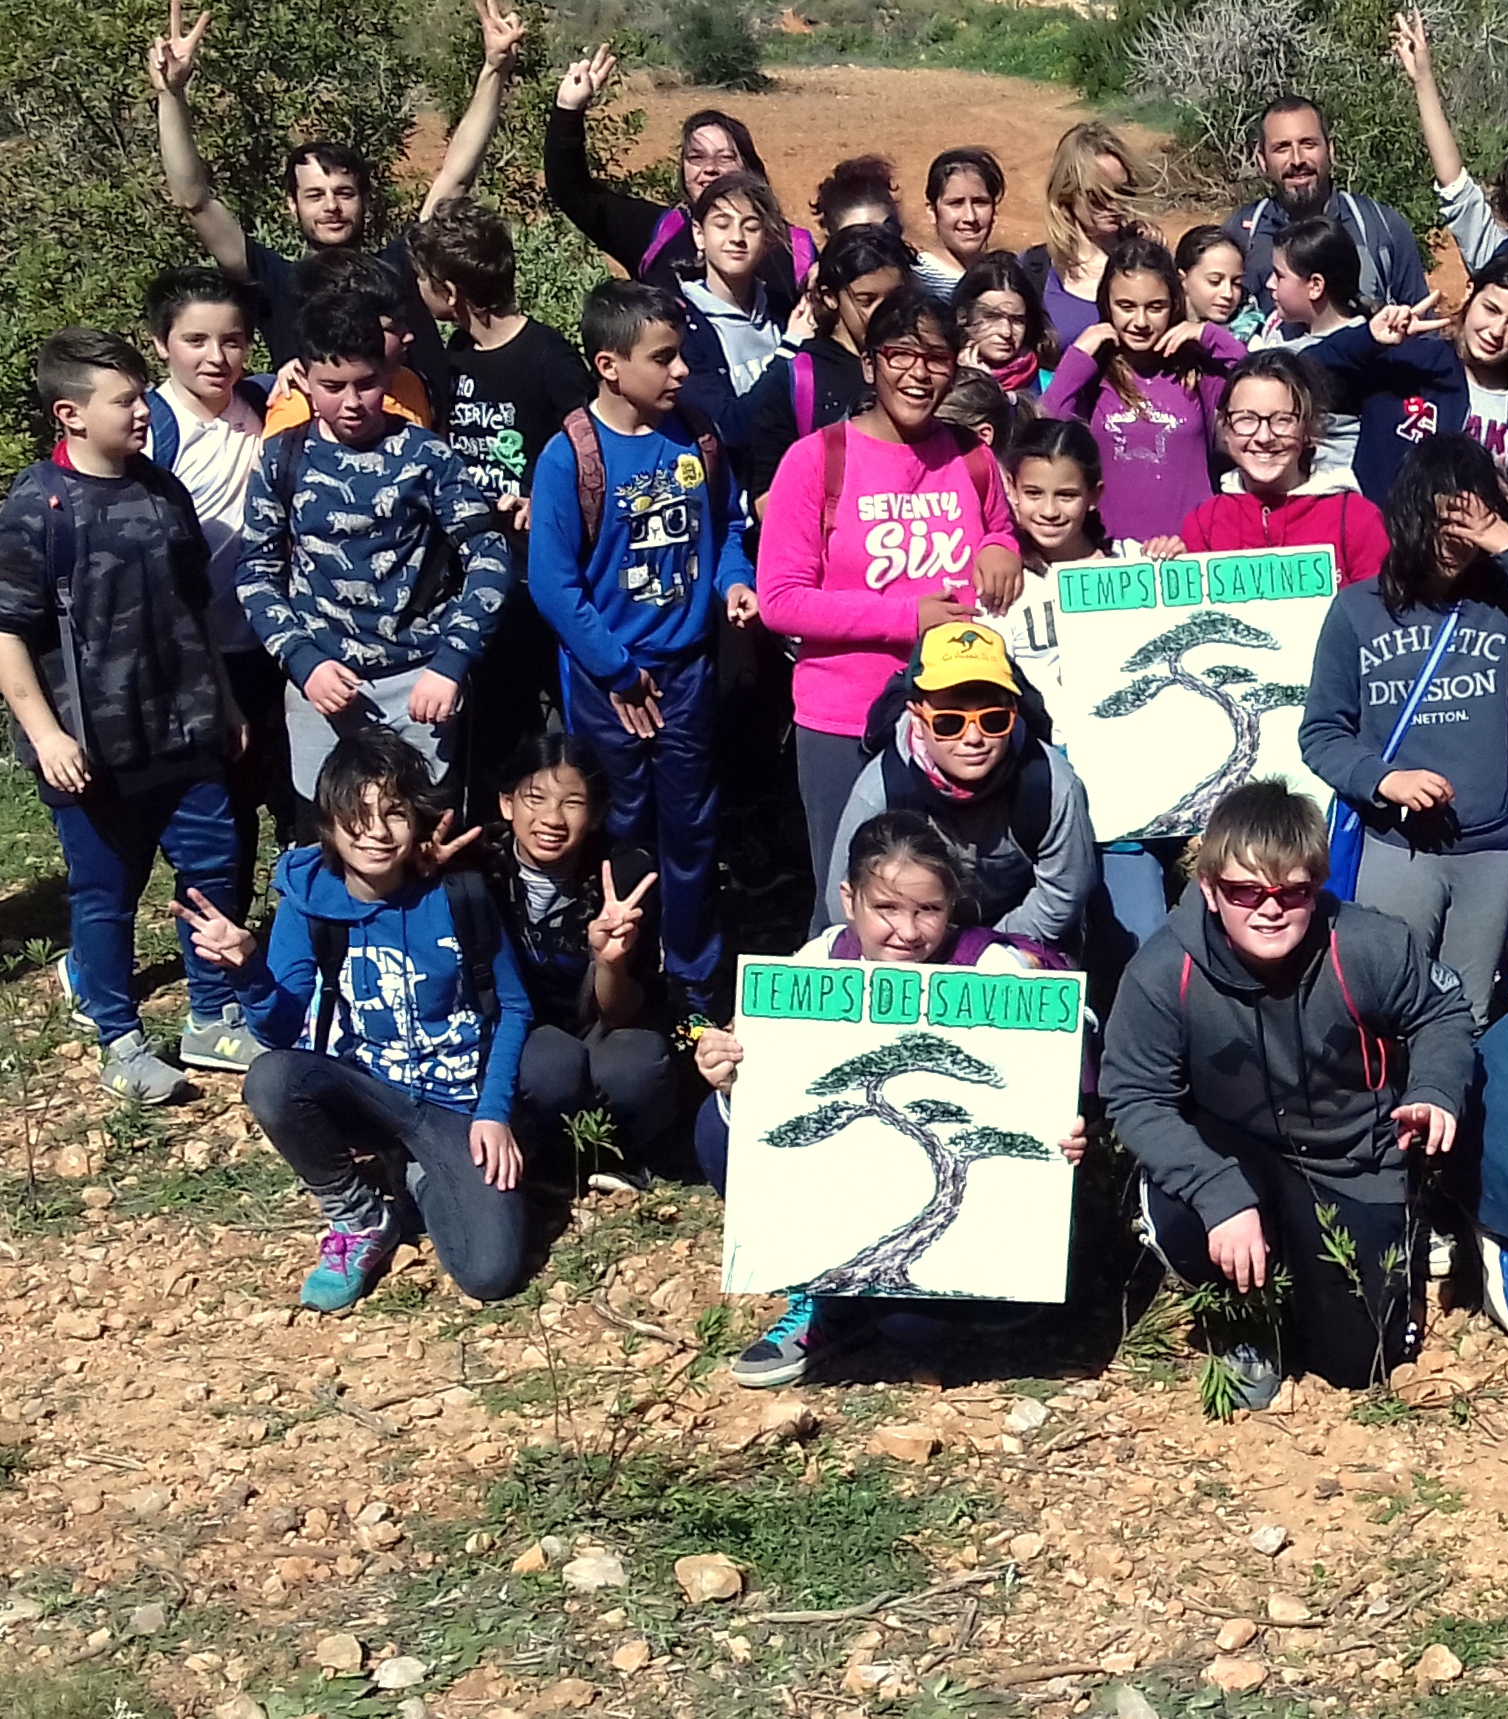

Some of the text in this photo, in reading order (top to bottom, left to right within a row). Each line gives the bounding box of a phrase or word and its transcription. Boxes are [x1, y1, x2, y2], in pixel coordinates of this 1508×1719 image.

[858, 491, 962, 521] SEVENTY
[865, 520, 971, 590] Six
[1061, 557, 1326, 607] TEMPS DE SAVINES
[1368, 669, 1497, 706] DIVSION
[1411, 709, 1470, 726] NETTON.
[750, 971, 1072, 1024] TEMPS DE SAVINES
